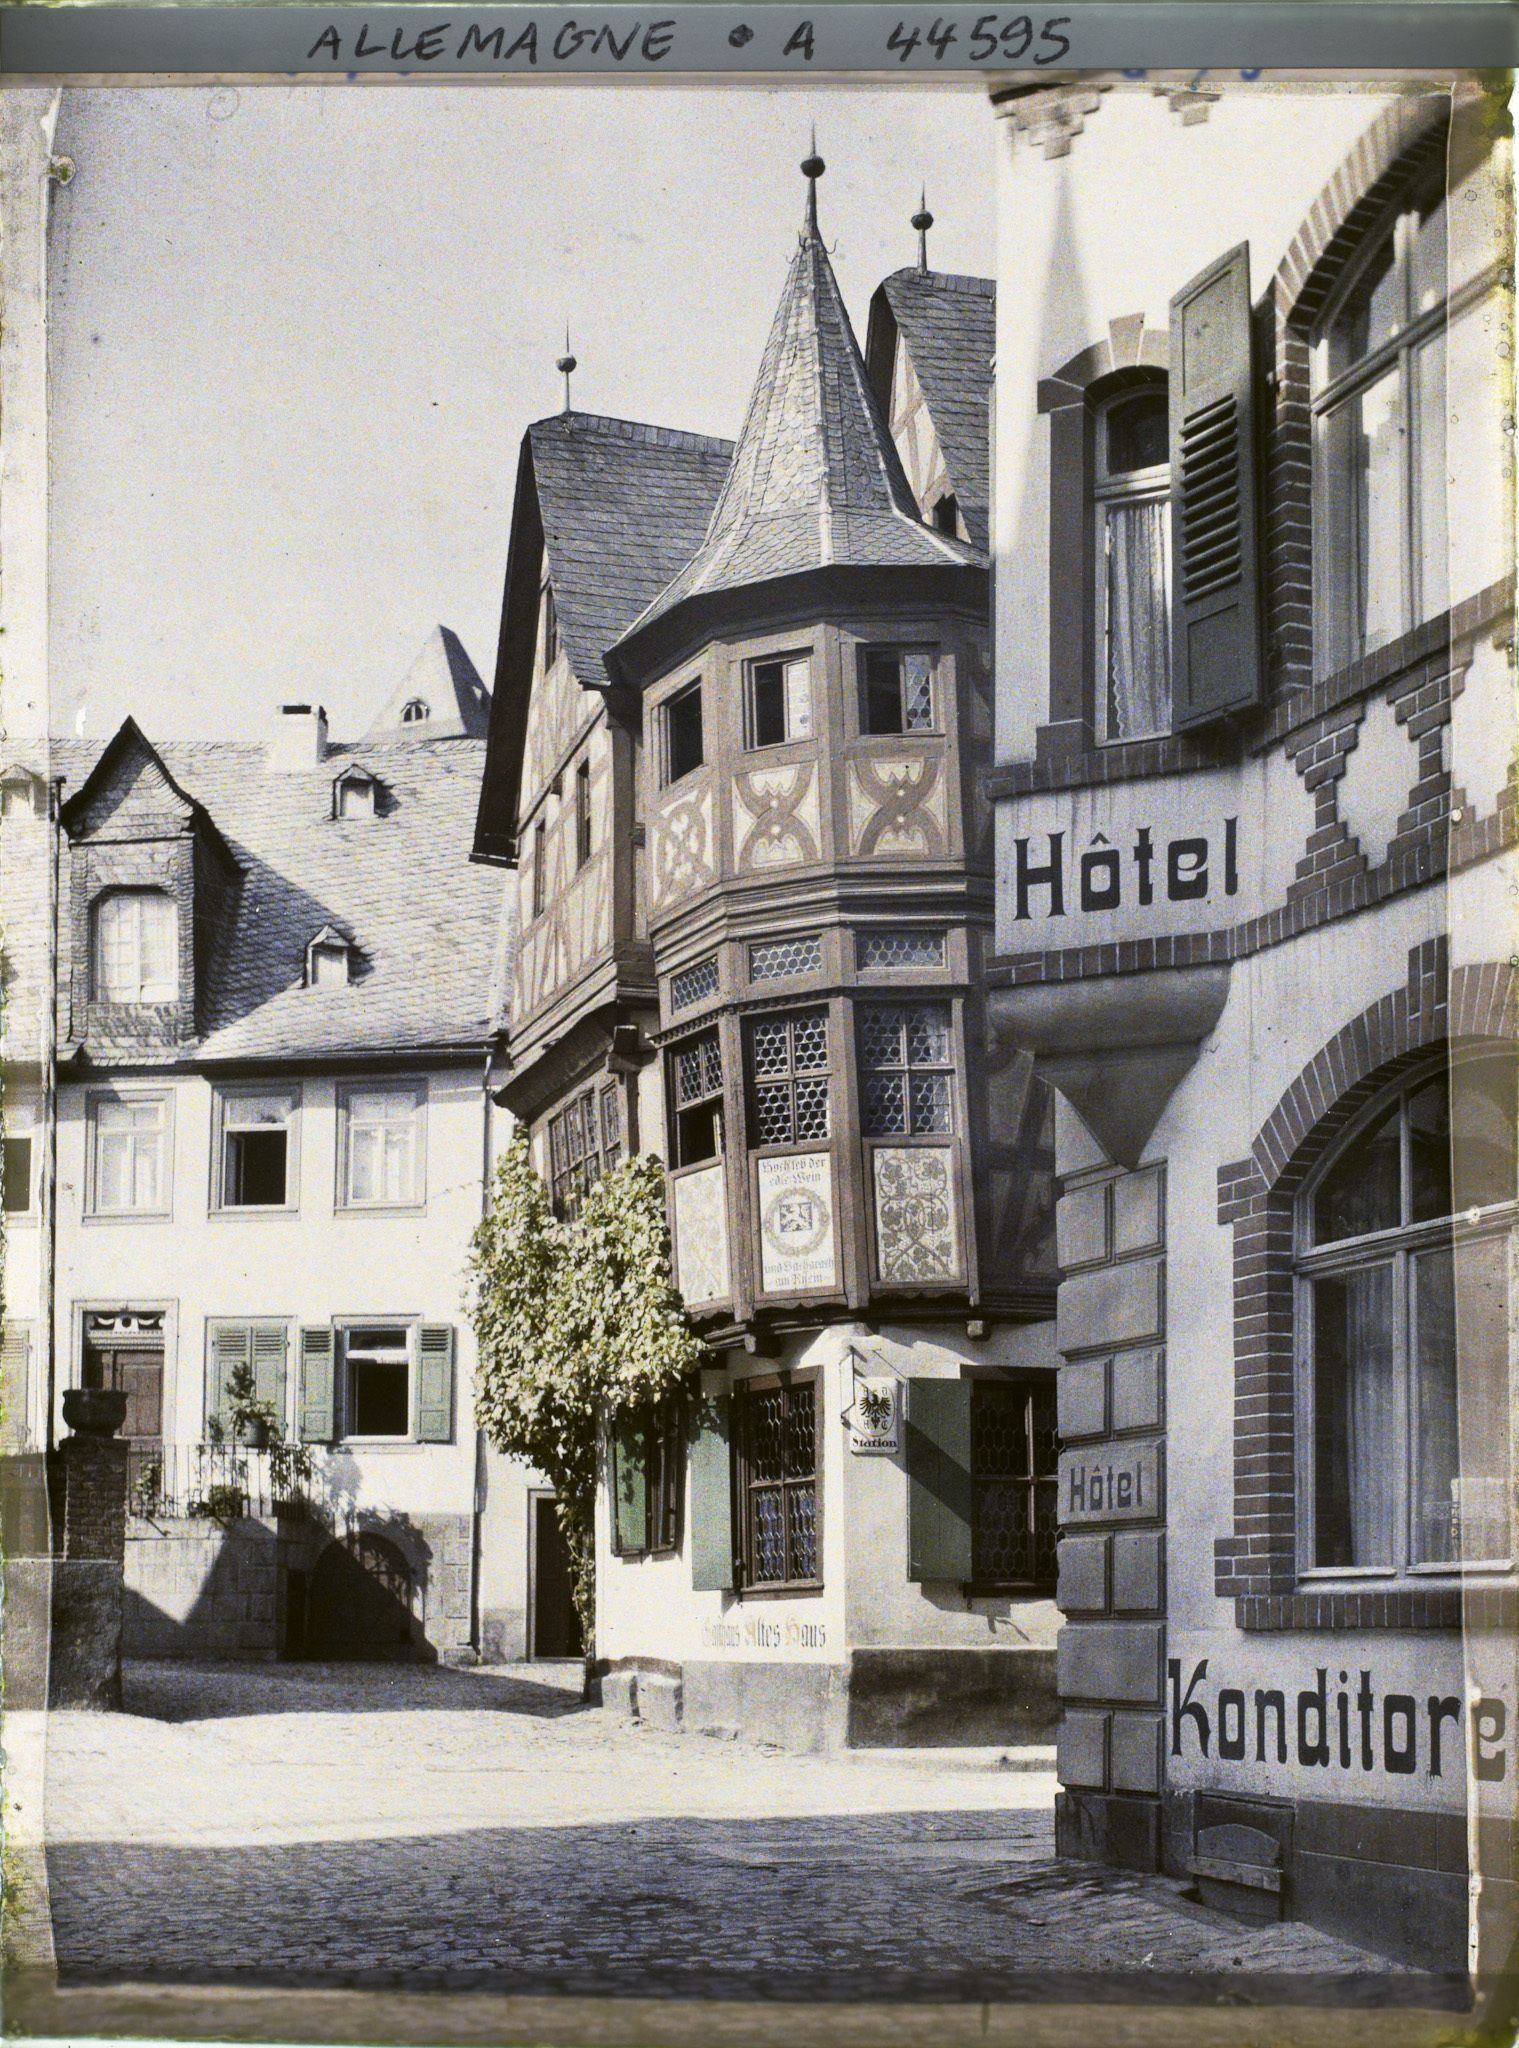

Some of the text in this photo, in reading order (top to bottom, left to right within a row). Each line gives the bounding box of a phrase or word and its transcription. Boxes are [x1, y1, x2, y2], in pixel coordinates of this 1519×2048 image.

[307, 15, 1072, 65] ALLEMAGNE A 44595
[1012, 815, 1239, 921] Hôtel
[852, 1437, 898, 1448] Station
[1069, 1461, 1143, 1513] Hôtel
